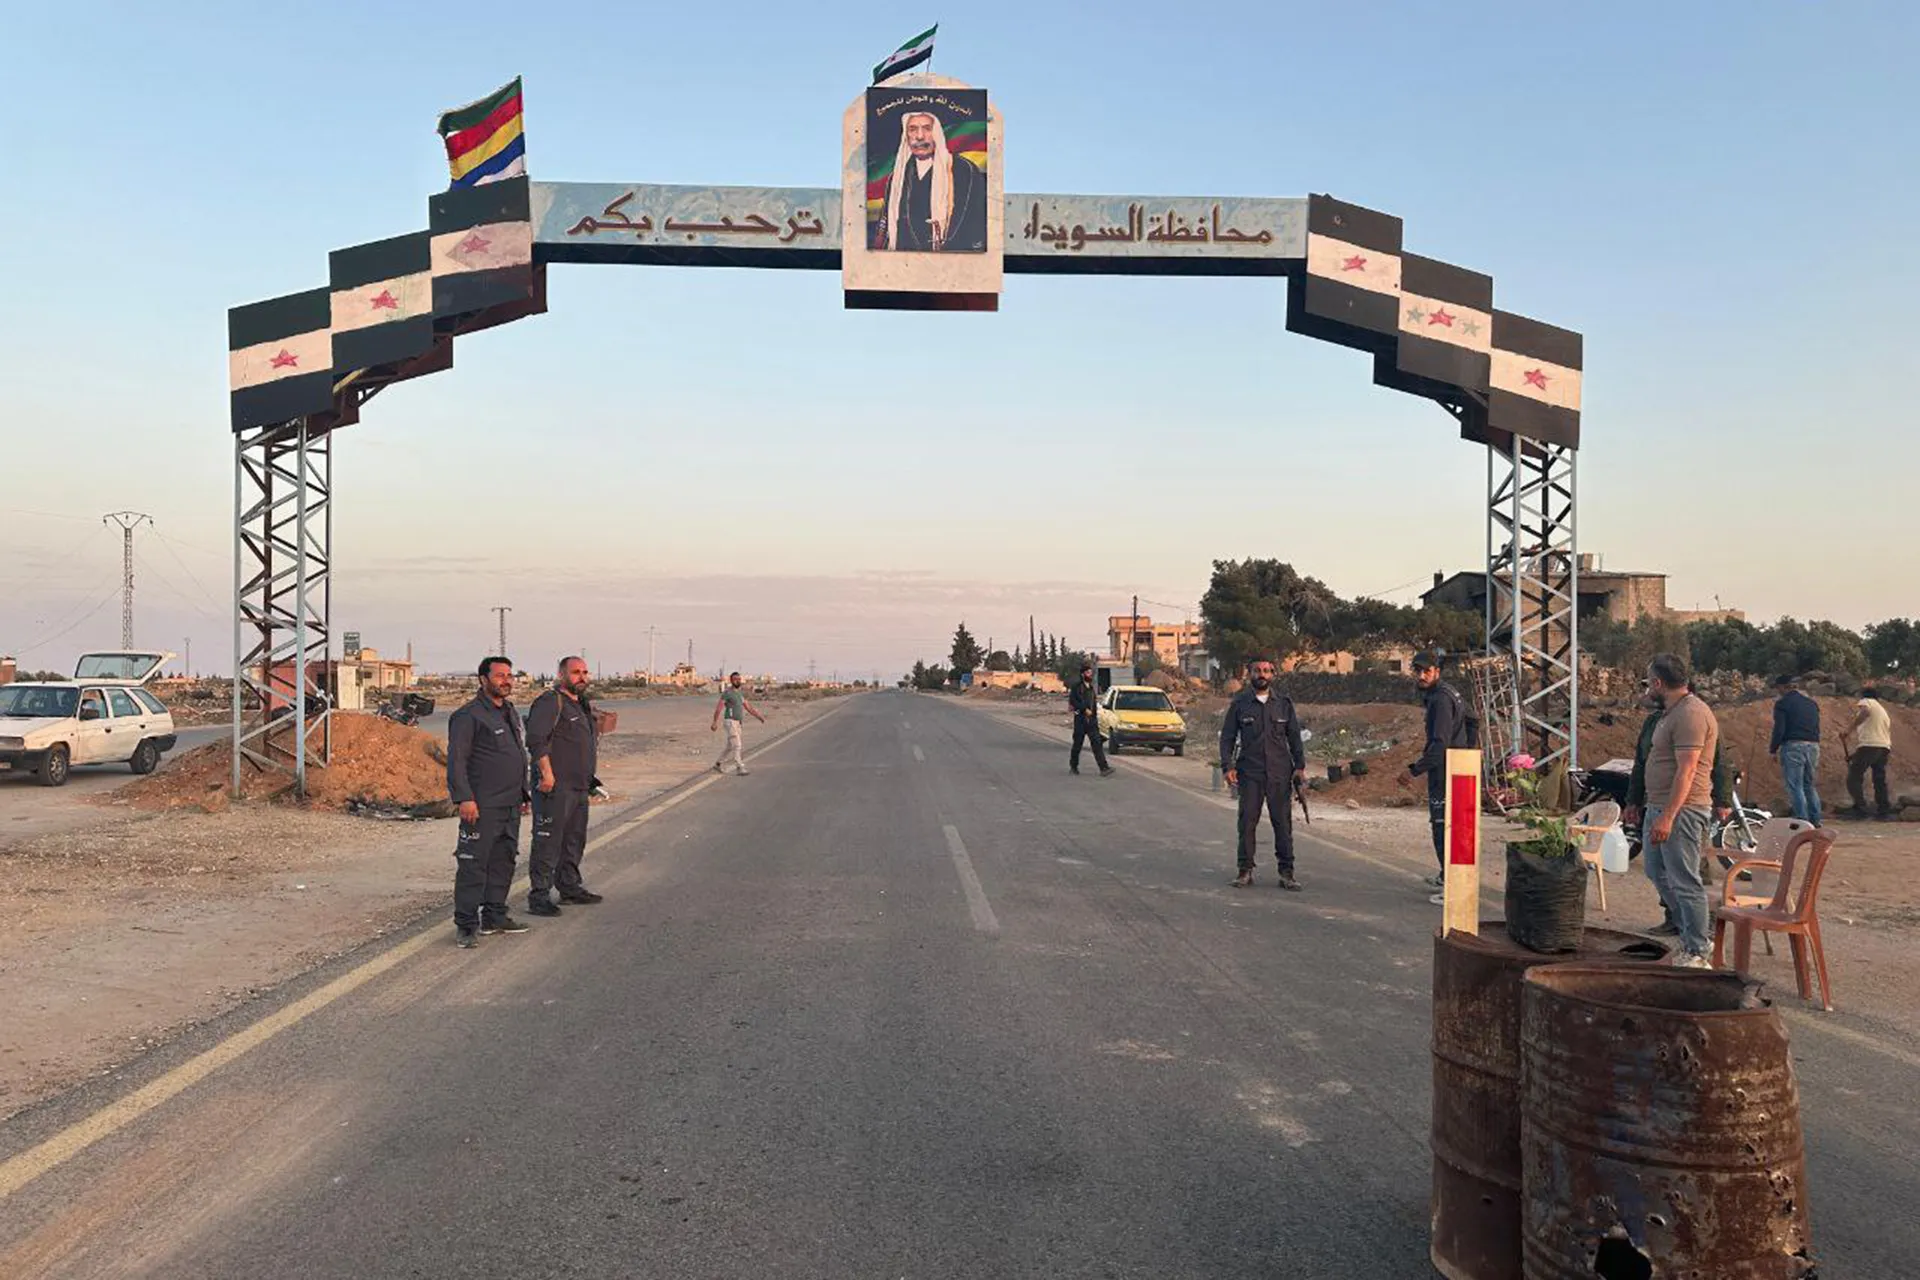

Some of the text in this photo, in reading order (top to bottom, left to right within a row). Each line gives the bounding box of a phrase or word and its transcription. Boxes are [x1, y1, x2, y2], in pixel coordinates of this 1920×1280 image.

[567, 191, 824, 242] ترحب بكم
[1023, 202, 1275, 250] محافظة السويداء
